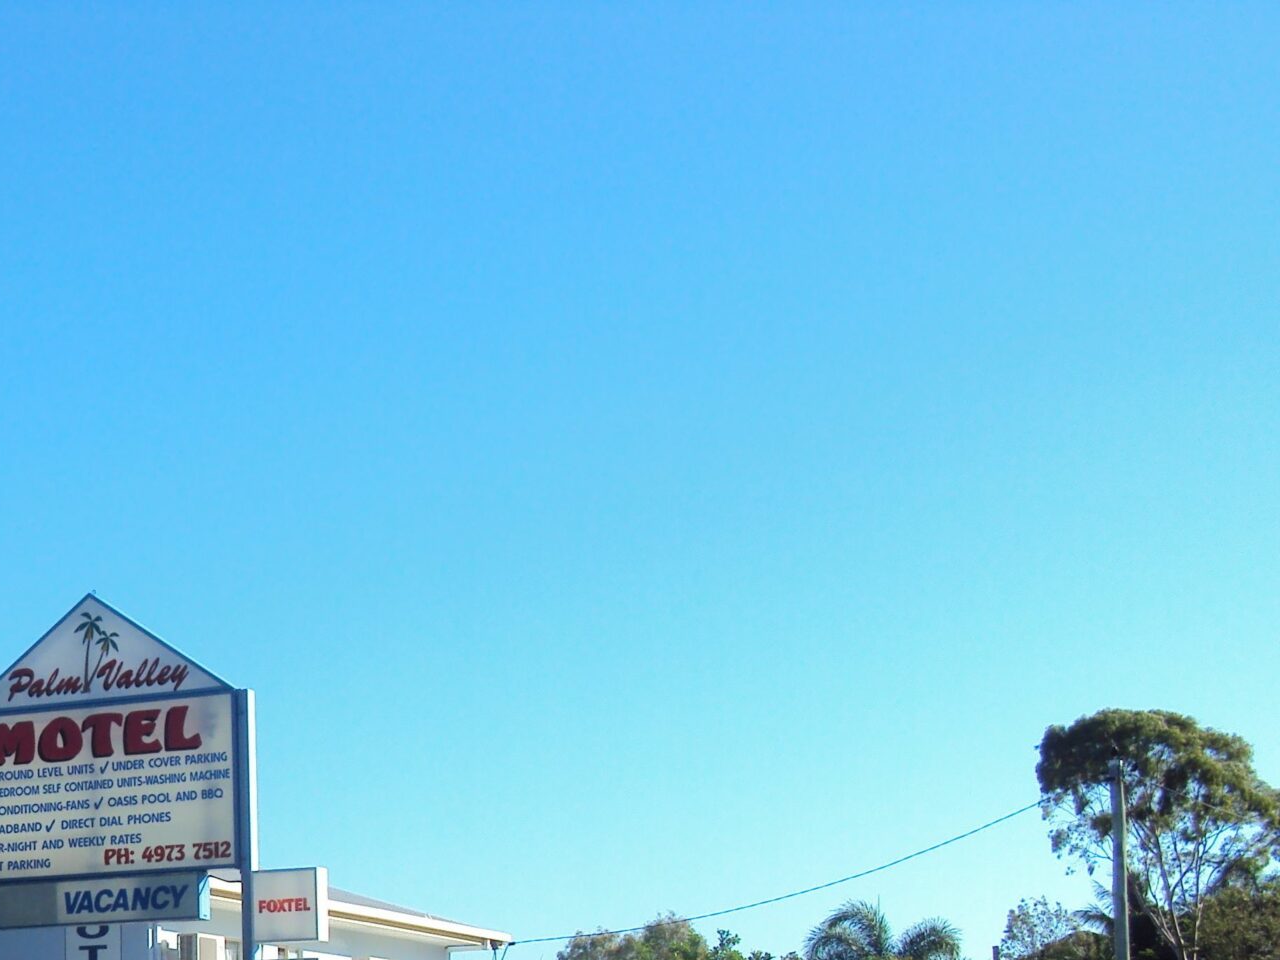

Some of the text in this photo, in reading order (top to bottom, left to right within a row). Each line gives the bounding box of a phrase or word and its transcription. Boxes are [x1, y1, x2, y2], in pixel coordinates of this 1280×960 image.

[8, 657, 189, 701] Palm Valley
[38, 766, 64, 778] LEVEL
[67, 763, 95, 775] UNITS
[112, 760, 144, 772] UNDER
[149, 755, 181, 768] COVER
[185, 751, 228, 765] PARKING
[43, 783, 61, 794] SELF
[65, 779, 114, 793] CONTAINED
[117, 772, 187, 788] UNITS-WASHING
[190, 768, 230, 782] MACHINE
[108, 795, 138, 808] OASIS
[141, 792, 171, 804] POOL
[175, 790, 198, 802] AND
[61, 817, 95, 830] DIRECT
[99, 814, 123, 827] DIAL
[127, 811, 172, 825] PHONES
[41, 838, 64, 850] AND
[68, 835, 106, 848] WEEKLY
[110, 833, 142, 845] RATES
[104, 841, 231, 865] PH: 4973 7512
[7, 858, 51, 871] PARKING
[64, 884, 189, 915] VACANCY
[258, 897, 311, 913] FOXTEL
